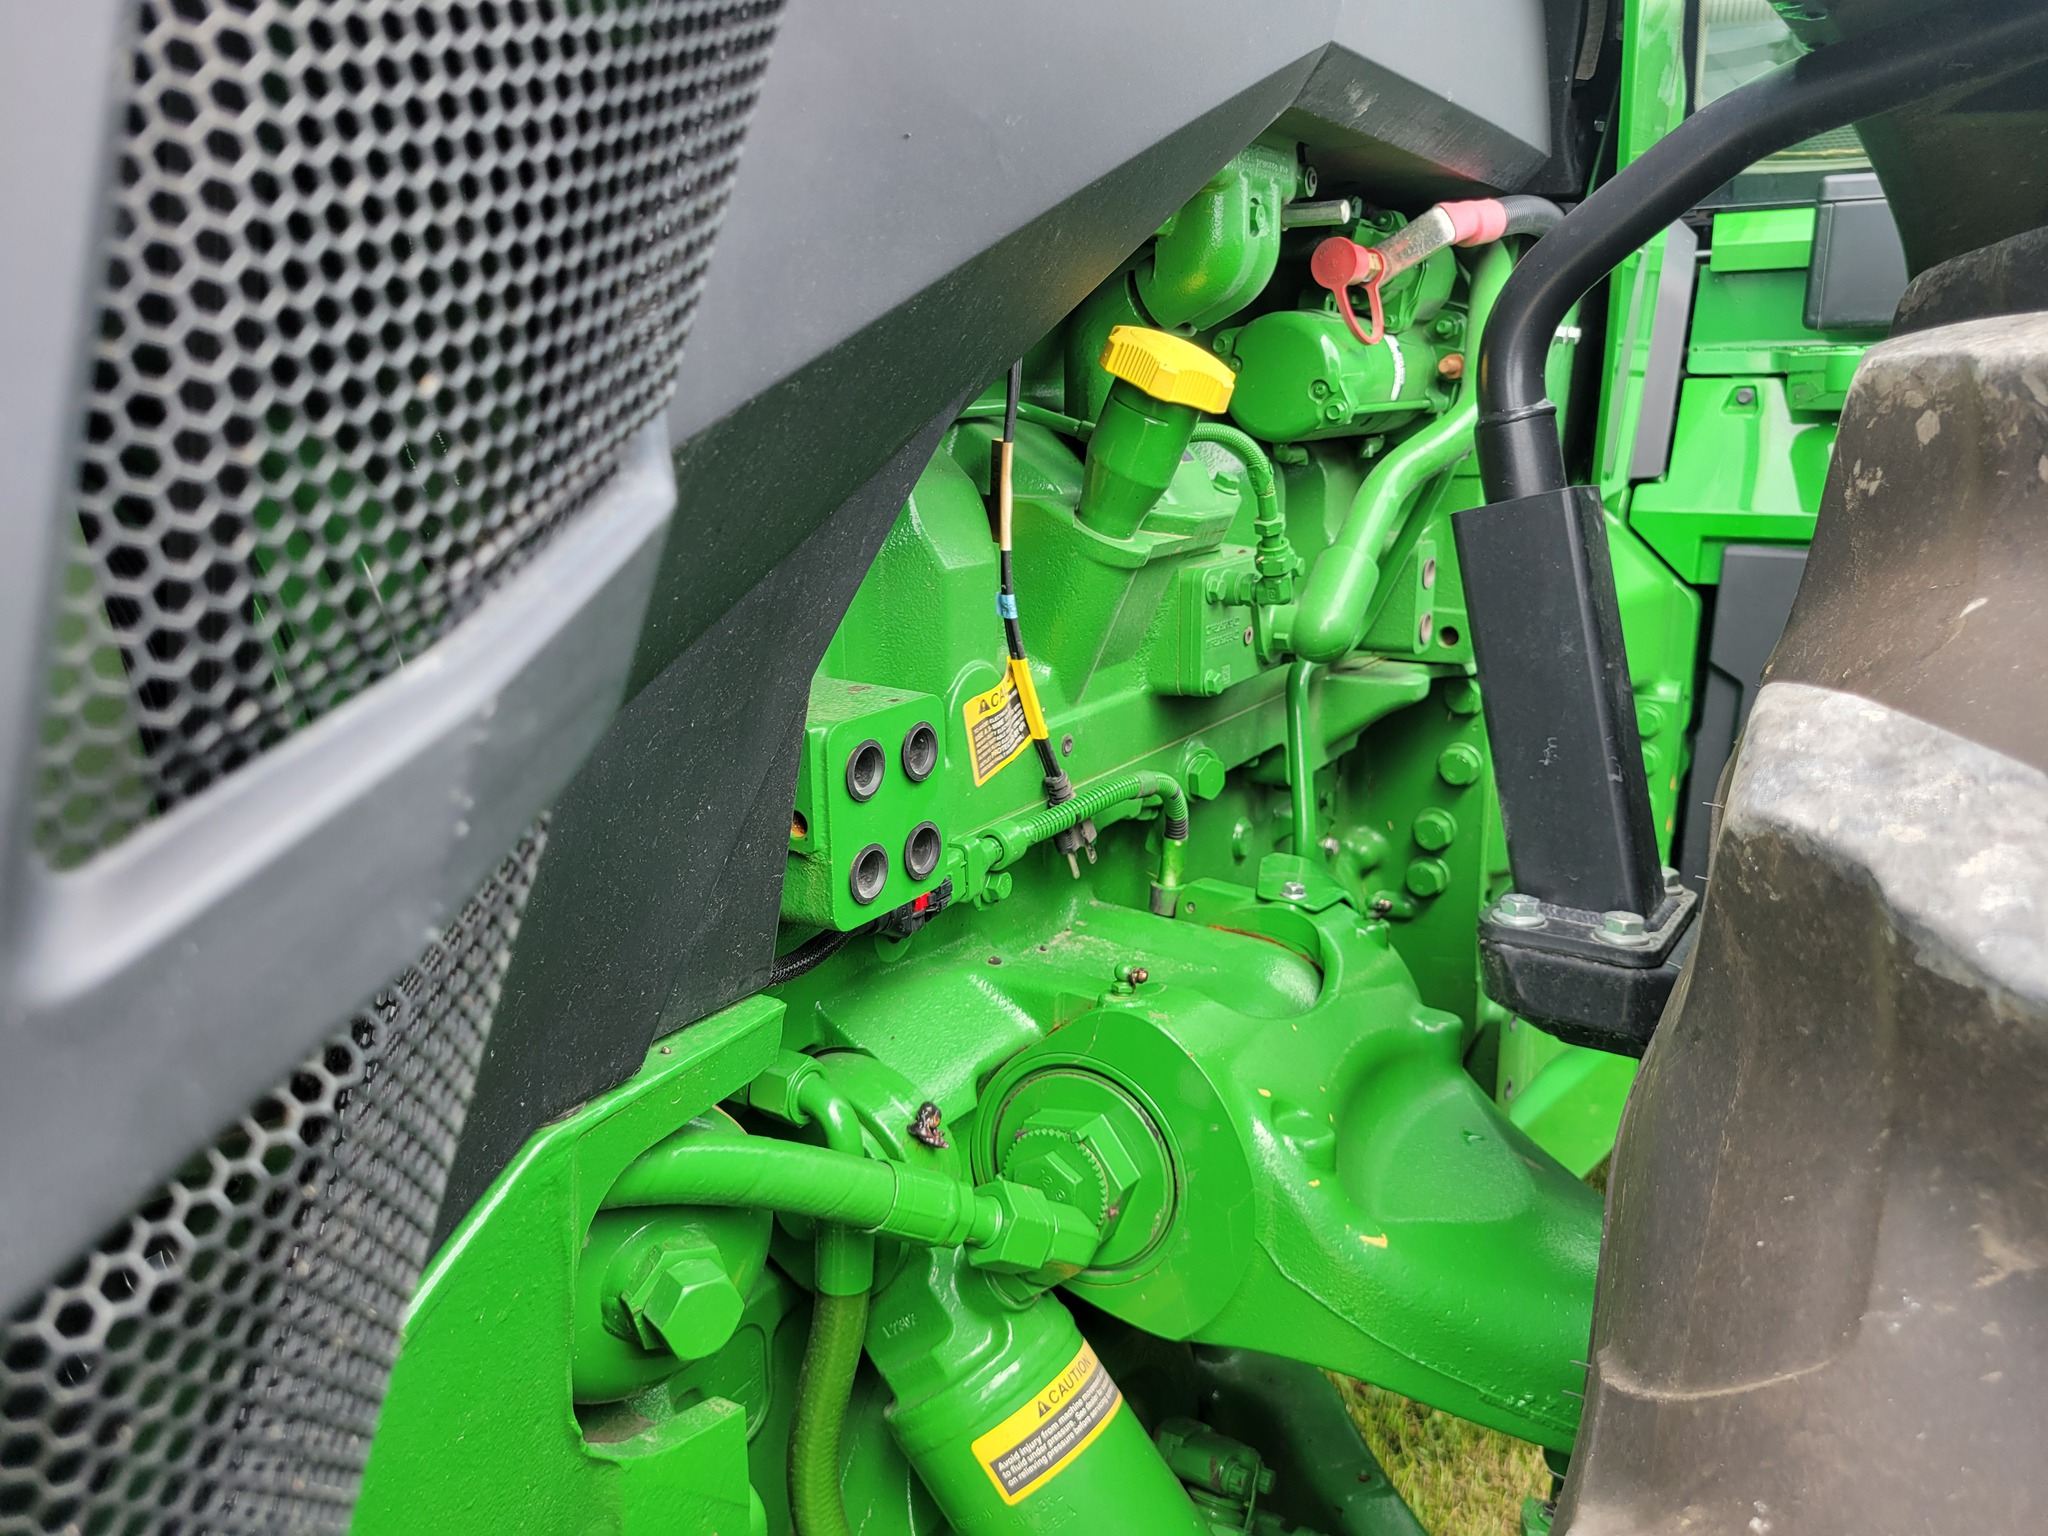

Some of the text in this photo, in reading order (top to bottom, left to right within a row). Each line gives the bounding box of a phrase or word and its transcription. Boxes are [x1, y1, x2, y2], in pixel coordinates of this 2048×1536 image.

[1048, 1355, 1091, 1404] CAUTION
[998, 1450, 1021, 1471] Avoid
[1018, 1435, 1042, 1457] injury
[1041, 1421, 1060, 1440] from
[1058, 1398, 1084, 1425] machine
[1002, 1470, 1012, 1480] to
[1010, 1456, 1028, 1474] fluid
[1026, 1442, 1048, 1464] under
[1075, 1407, 1087, 1420] See
[1007, 1476, 1019, 1488] on
[1017, 1454, 1049, 1481] relieving
[1046, 1431, 1075, 1461] pressure
[1073, 1415, 1092, 1436] before
